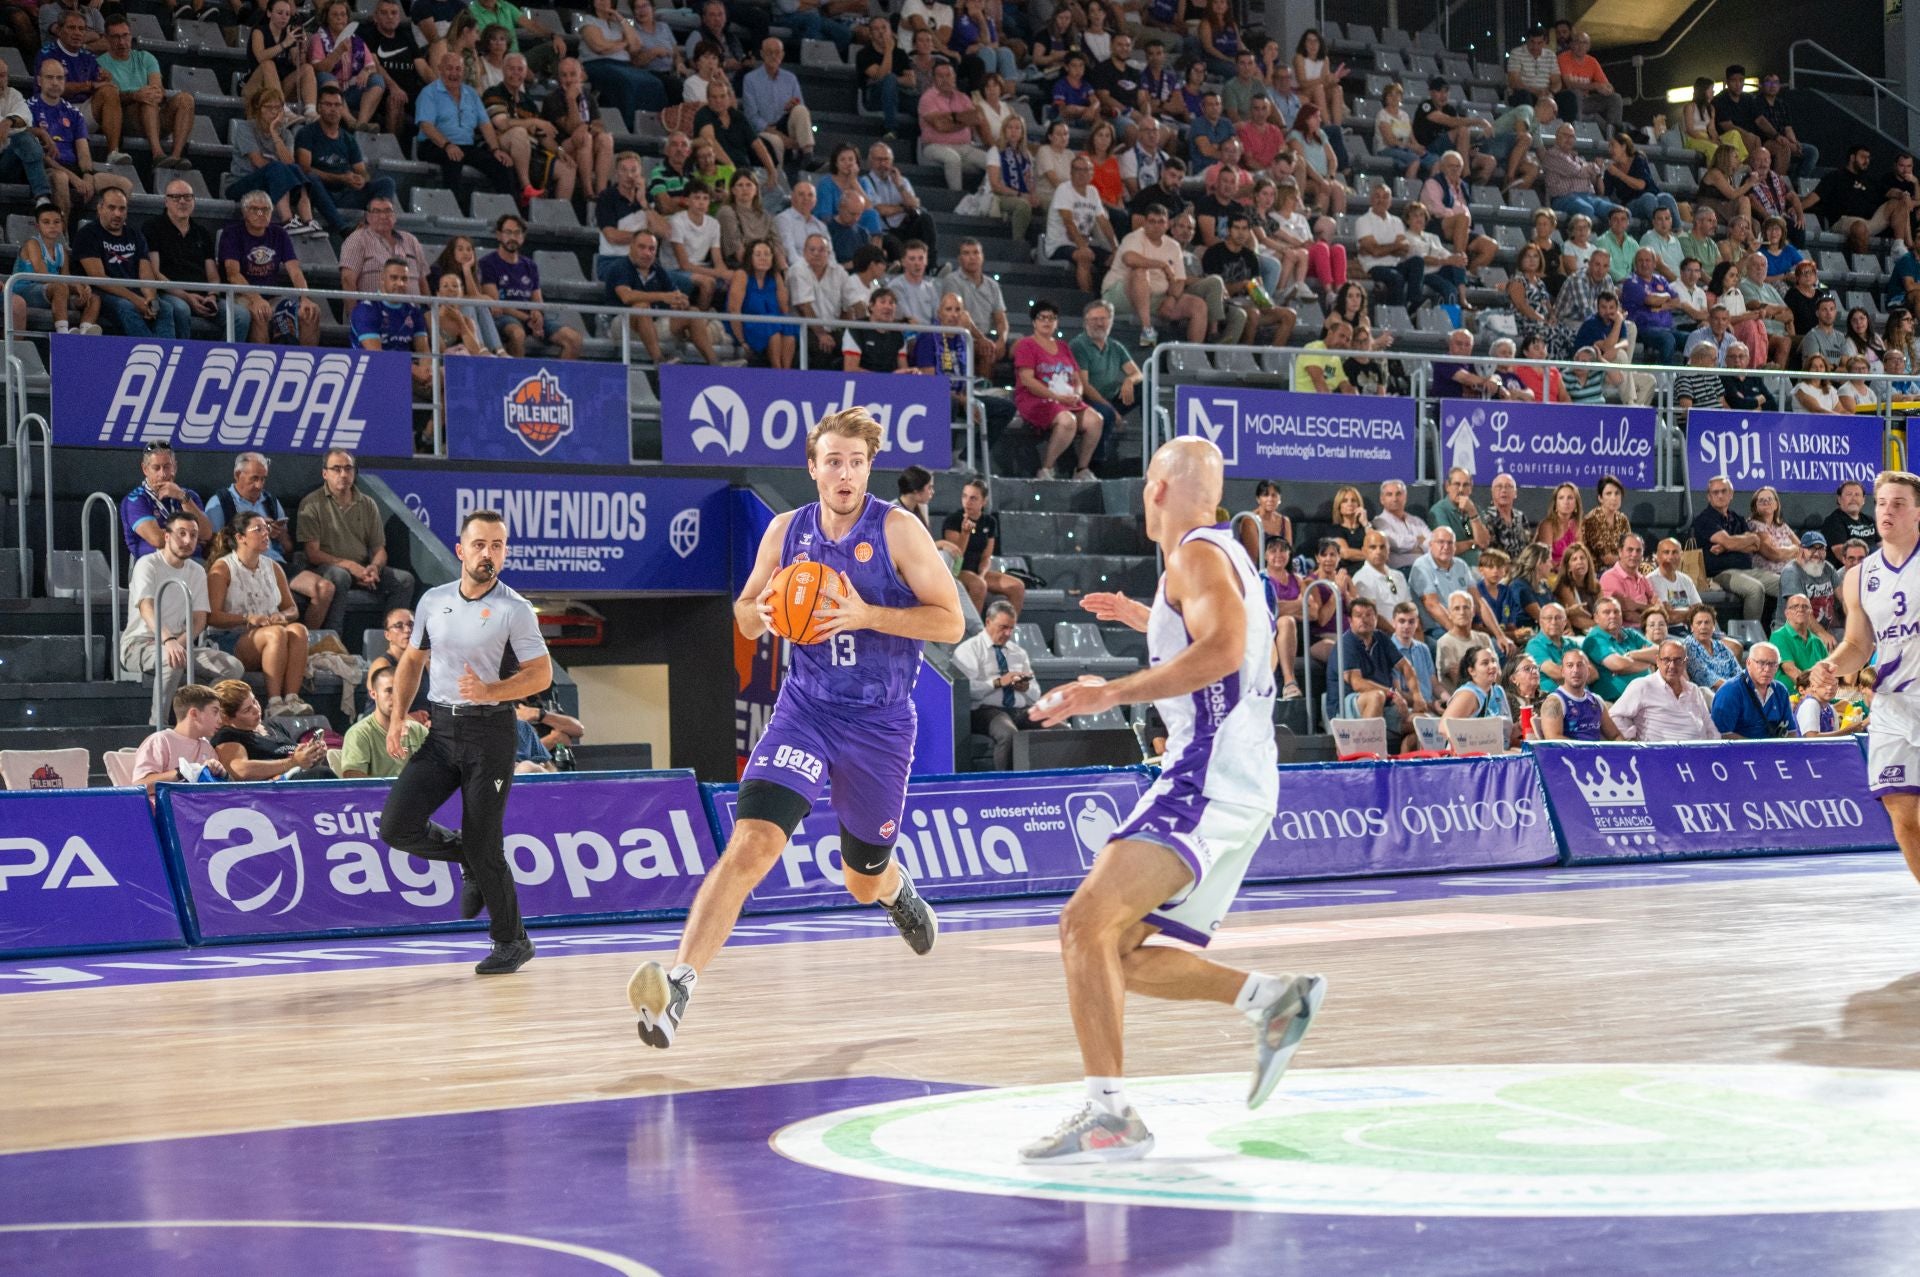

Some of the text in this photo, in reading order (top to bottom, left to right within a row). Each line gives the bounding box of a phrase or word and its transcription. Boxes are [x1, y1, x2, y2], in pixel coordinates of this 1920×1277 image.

[99, 343, 370, 449] ALCOPAL
[508, 403, 570, 426] PALENCIA
[1245, 413, 1405, 440] MORALESCERVERA
[1490, 411, 1652, 457] La casa dulce
[1778, 432, 1850, 456] SABORES
[1317, 444, 1347, 459] Dental
[1349, 446, 1392, 460] Inmediata
[1583, 464, 1635, 476] CATERING
[1780, 460, 1876, 482] PALENTINOS
[1892, 590, 1907, 617] 3
[829, 633, 857, 667] 13
[773, 744, 823, 780] gaza
[1676, 759, 1822, 783] HOTEL
[313, 805, 382, 840] súp
[980, 803, 1062, 820] autoservicios
[1401, 794, 1538, 844] ópticos
[1594, 815, 1653, 828] REY SANCHO
[1672, 798, 1863, 834] REY SANCHO
[1023, 819, 1066, 833] ahorro
[326, 810, 705, 907] agopal
